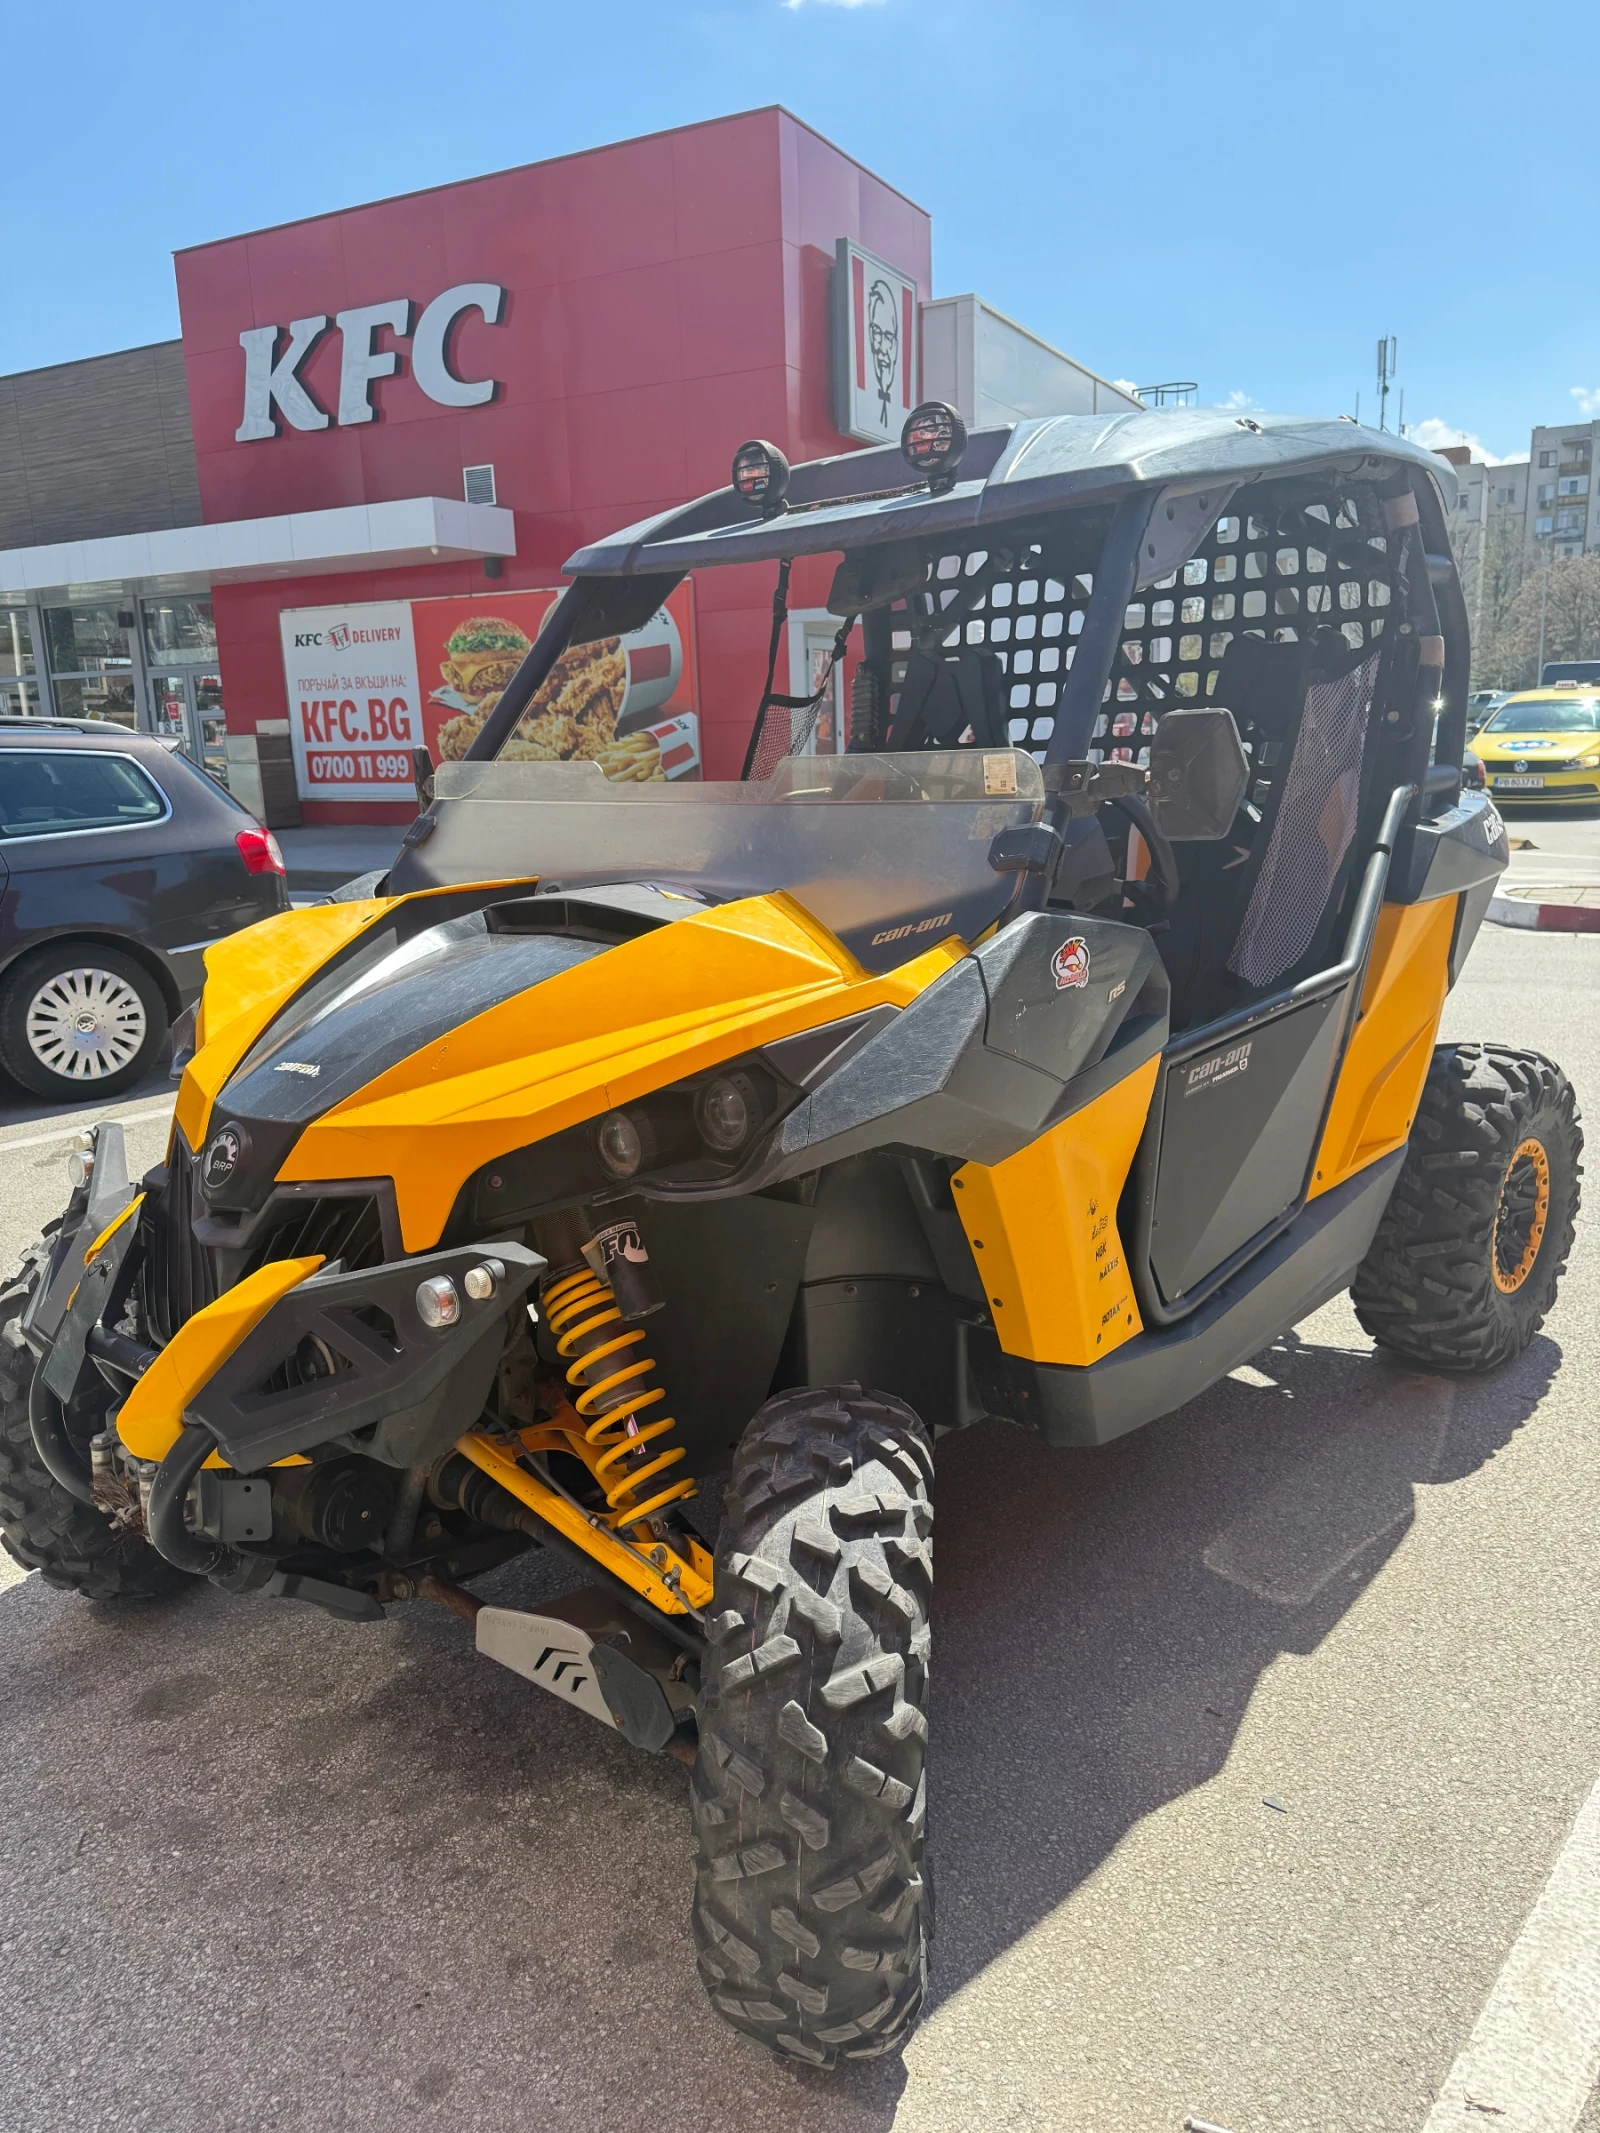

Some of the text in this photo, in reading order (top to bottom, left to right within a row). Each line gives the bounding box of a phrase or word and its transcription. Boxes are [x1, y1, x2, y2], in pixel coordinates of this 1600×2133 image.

[235, 283, 503, 442] KFC
[295, 627, 401, 647] KFC DELIVERY
[298, 673, 407, 692] ПОРЪЧАЙ ЗА ВКЪЩИ НА:
[300, 697, 412, 743] KFC.BG
[312, 754, 409, 779] 0700 11 999
[871, 912, 953, 945] can-am
[1188, 1042, 1252, 1084] can-am
[212, 1160, 233, 1171] BRP
